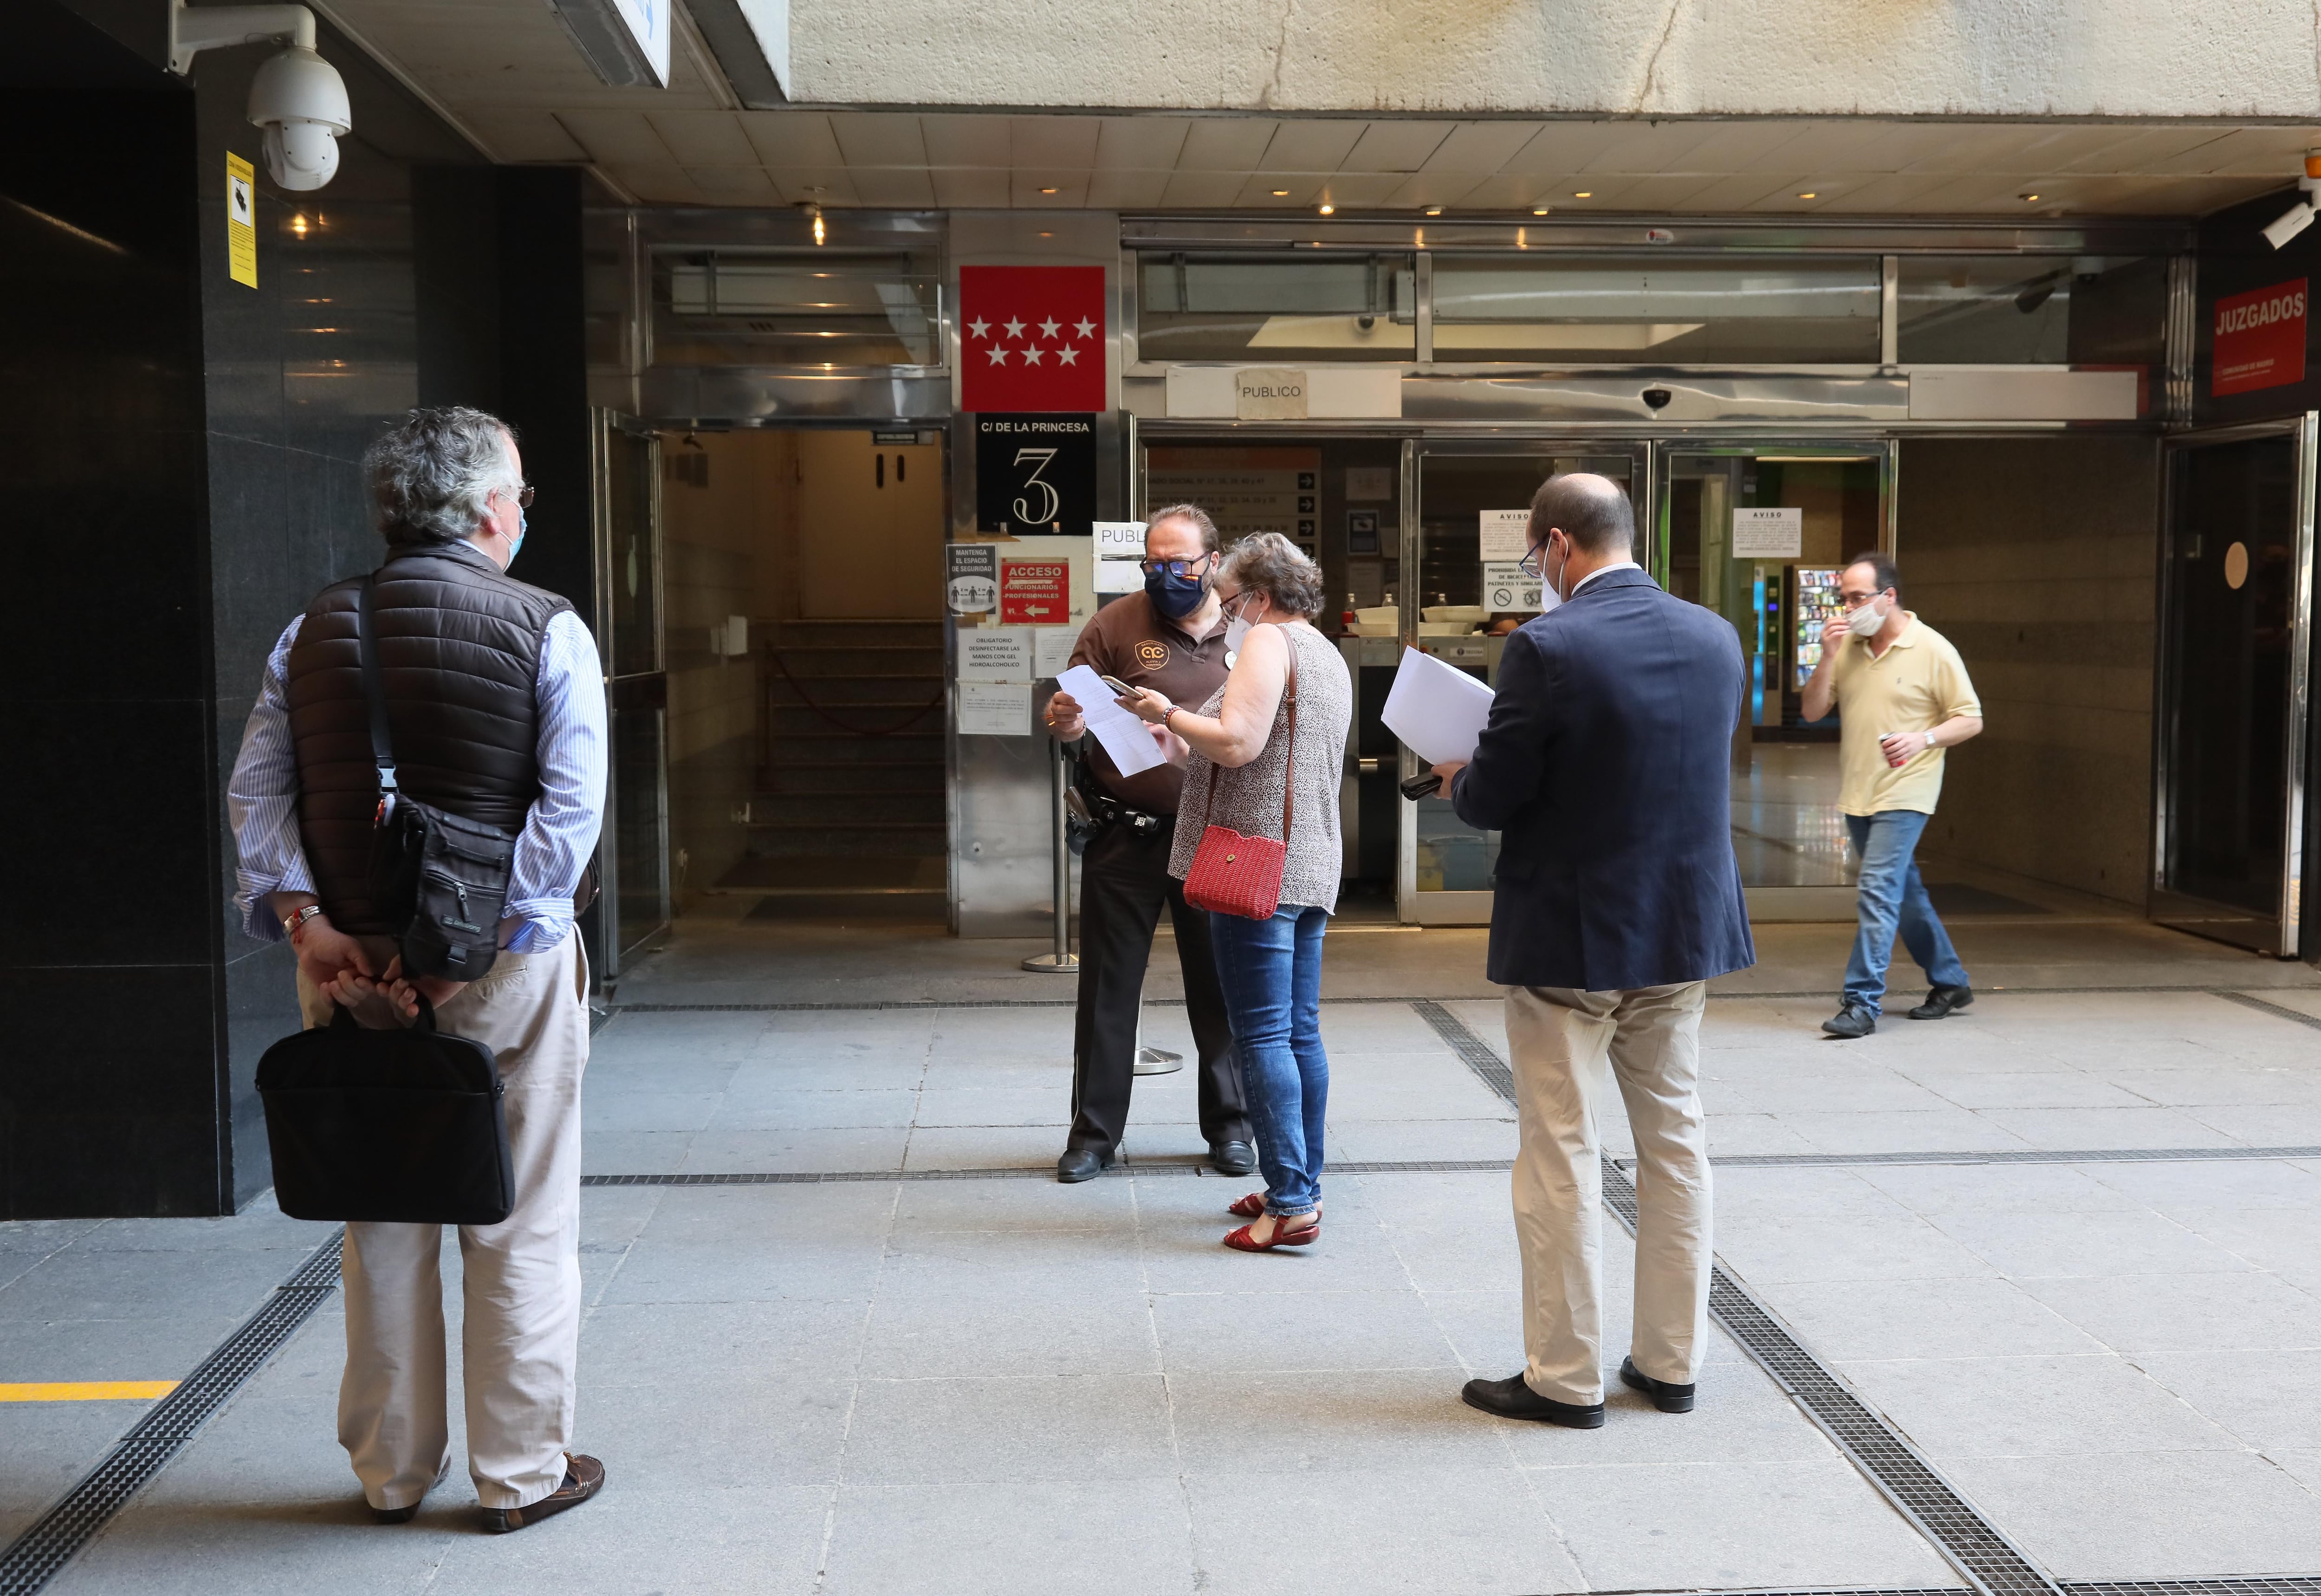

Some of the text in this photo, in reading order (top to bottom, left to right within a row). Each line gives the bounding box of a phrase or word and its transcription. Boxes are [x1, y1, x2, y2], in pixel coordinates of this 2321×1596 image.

[2216, 292, 2304, 336] JUZGADOS
[1243, 386, 1301, 397] PUBLICO
[981, 422, 1089, 432] C/ DE LA PRINCESA
[1013, 448, 1058, 524] 3
[1102, 530, 1144, 542] PUBL
[1008, 567, 1062, 577] ACCESO
